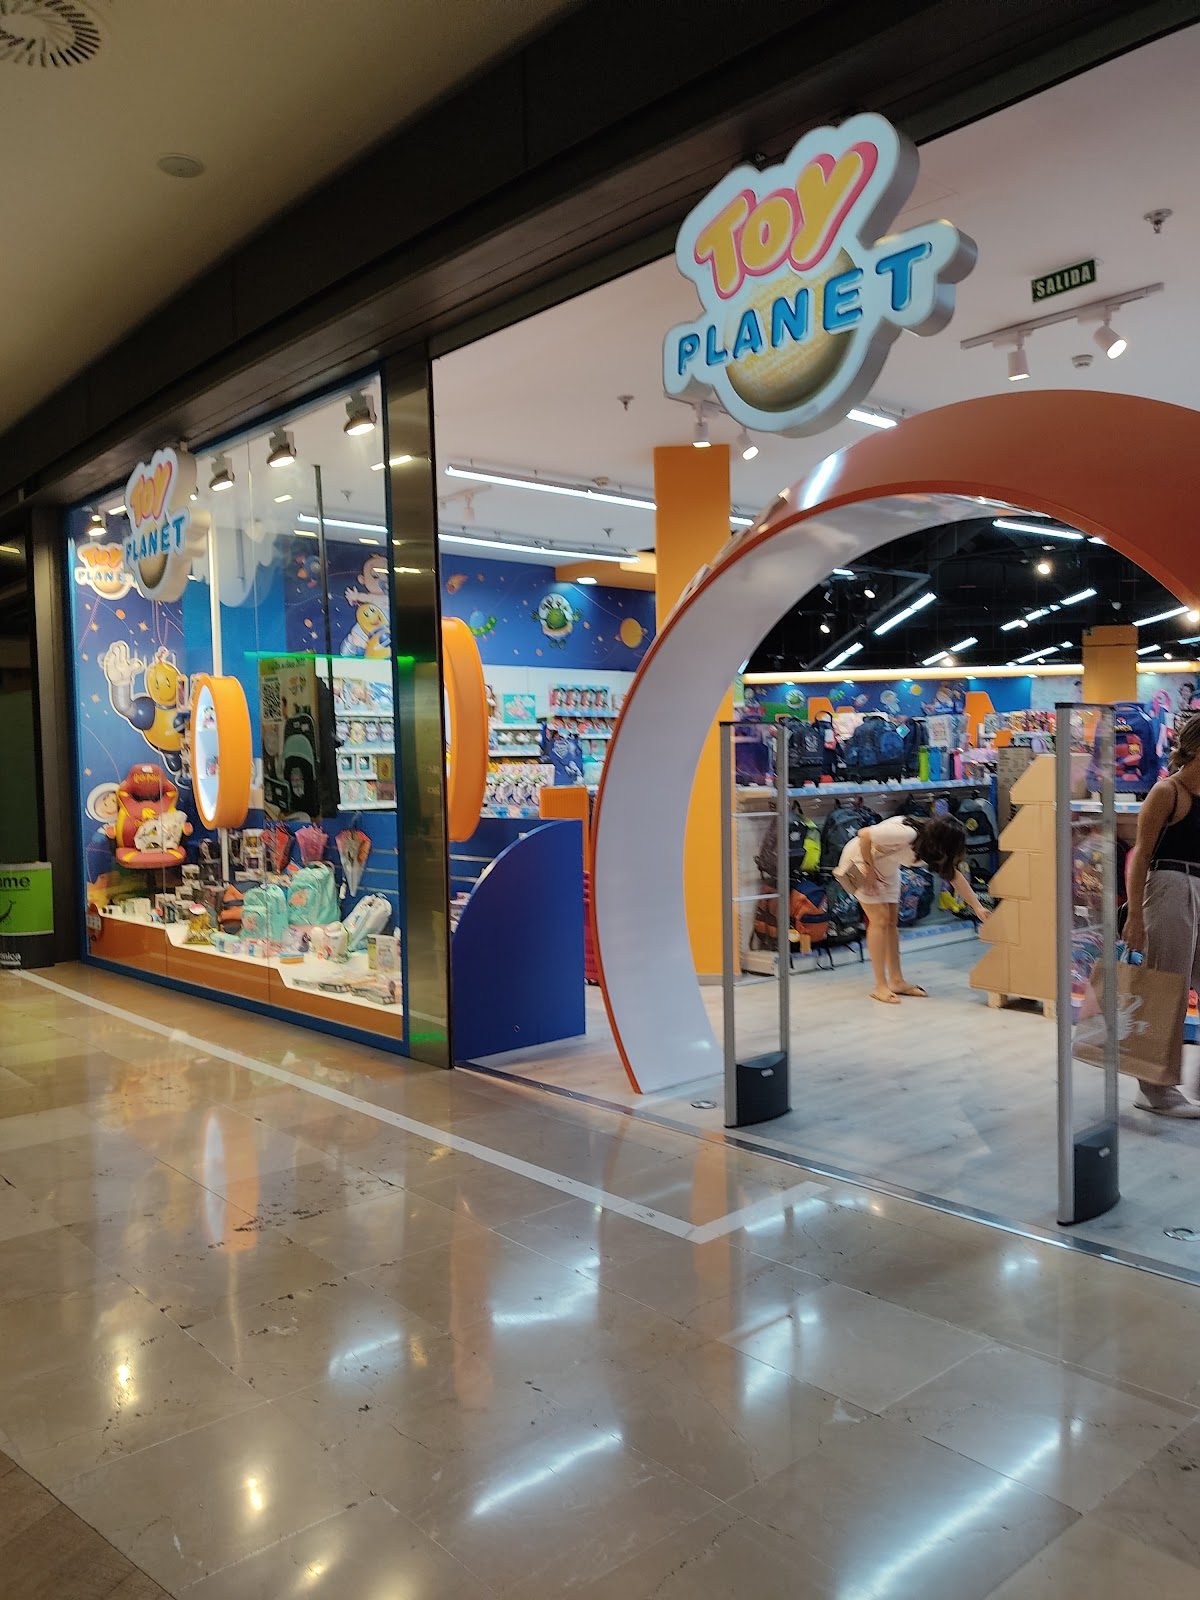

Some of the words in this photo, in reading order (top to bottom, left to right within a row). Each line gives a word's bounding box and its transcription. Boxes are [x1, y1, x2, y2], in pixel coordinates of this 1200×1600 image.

[694, 141, 879, 300] TOY
[1035, 265, 1092, 298] SALIDA
[677, 241, 933, 376] PLANET
[125, 515, 185, 562] PLANET
[78, 570, 125, 584] PLANE
